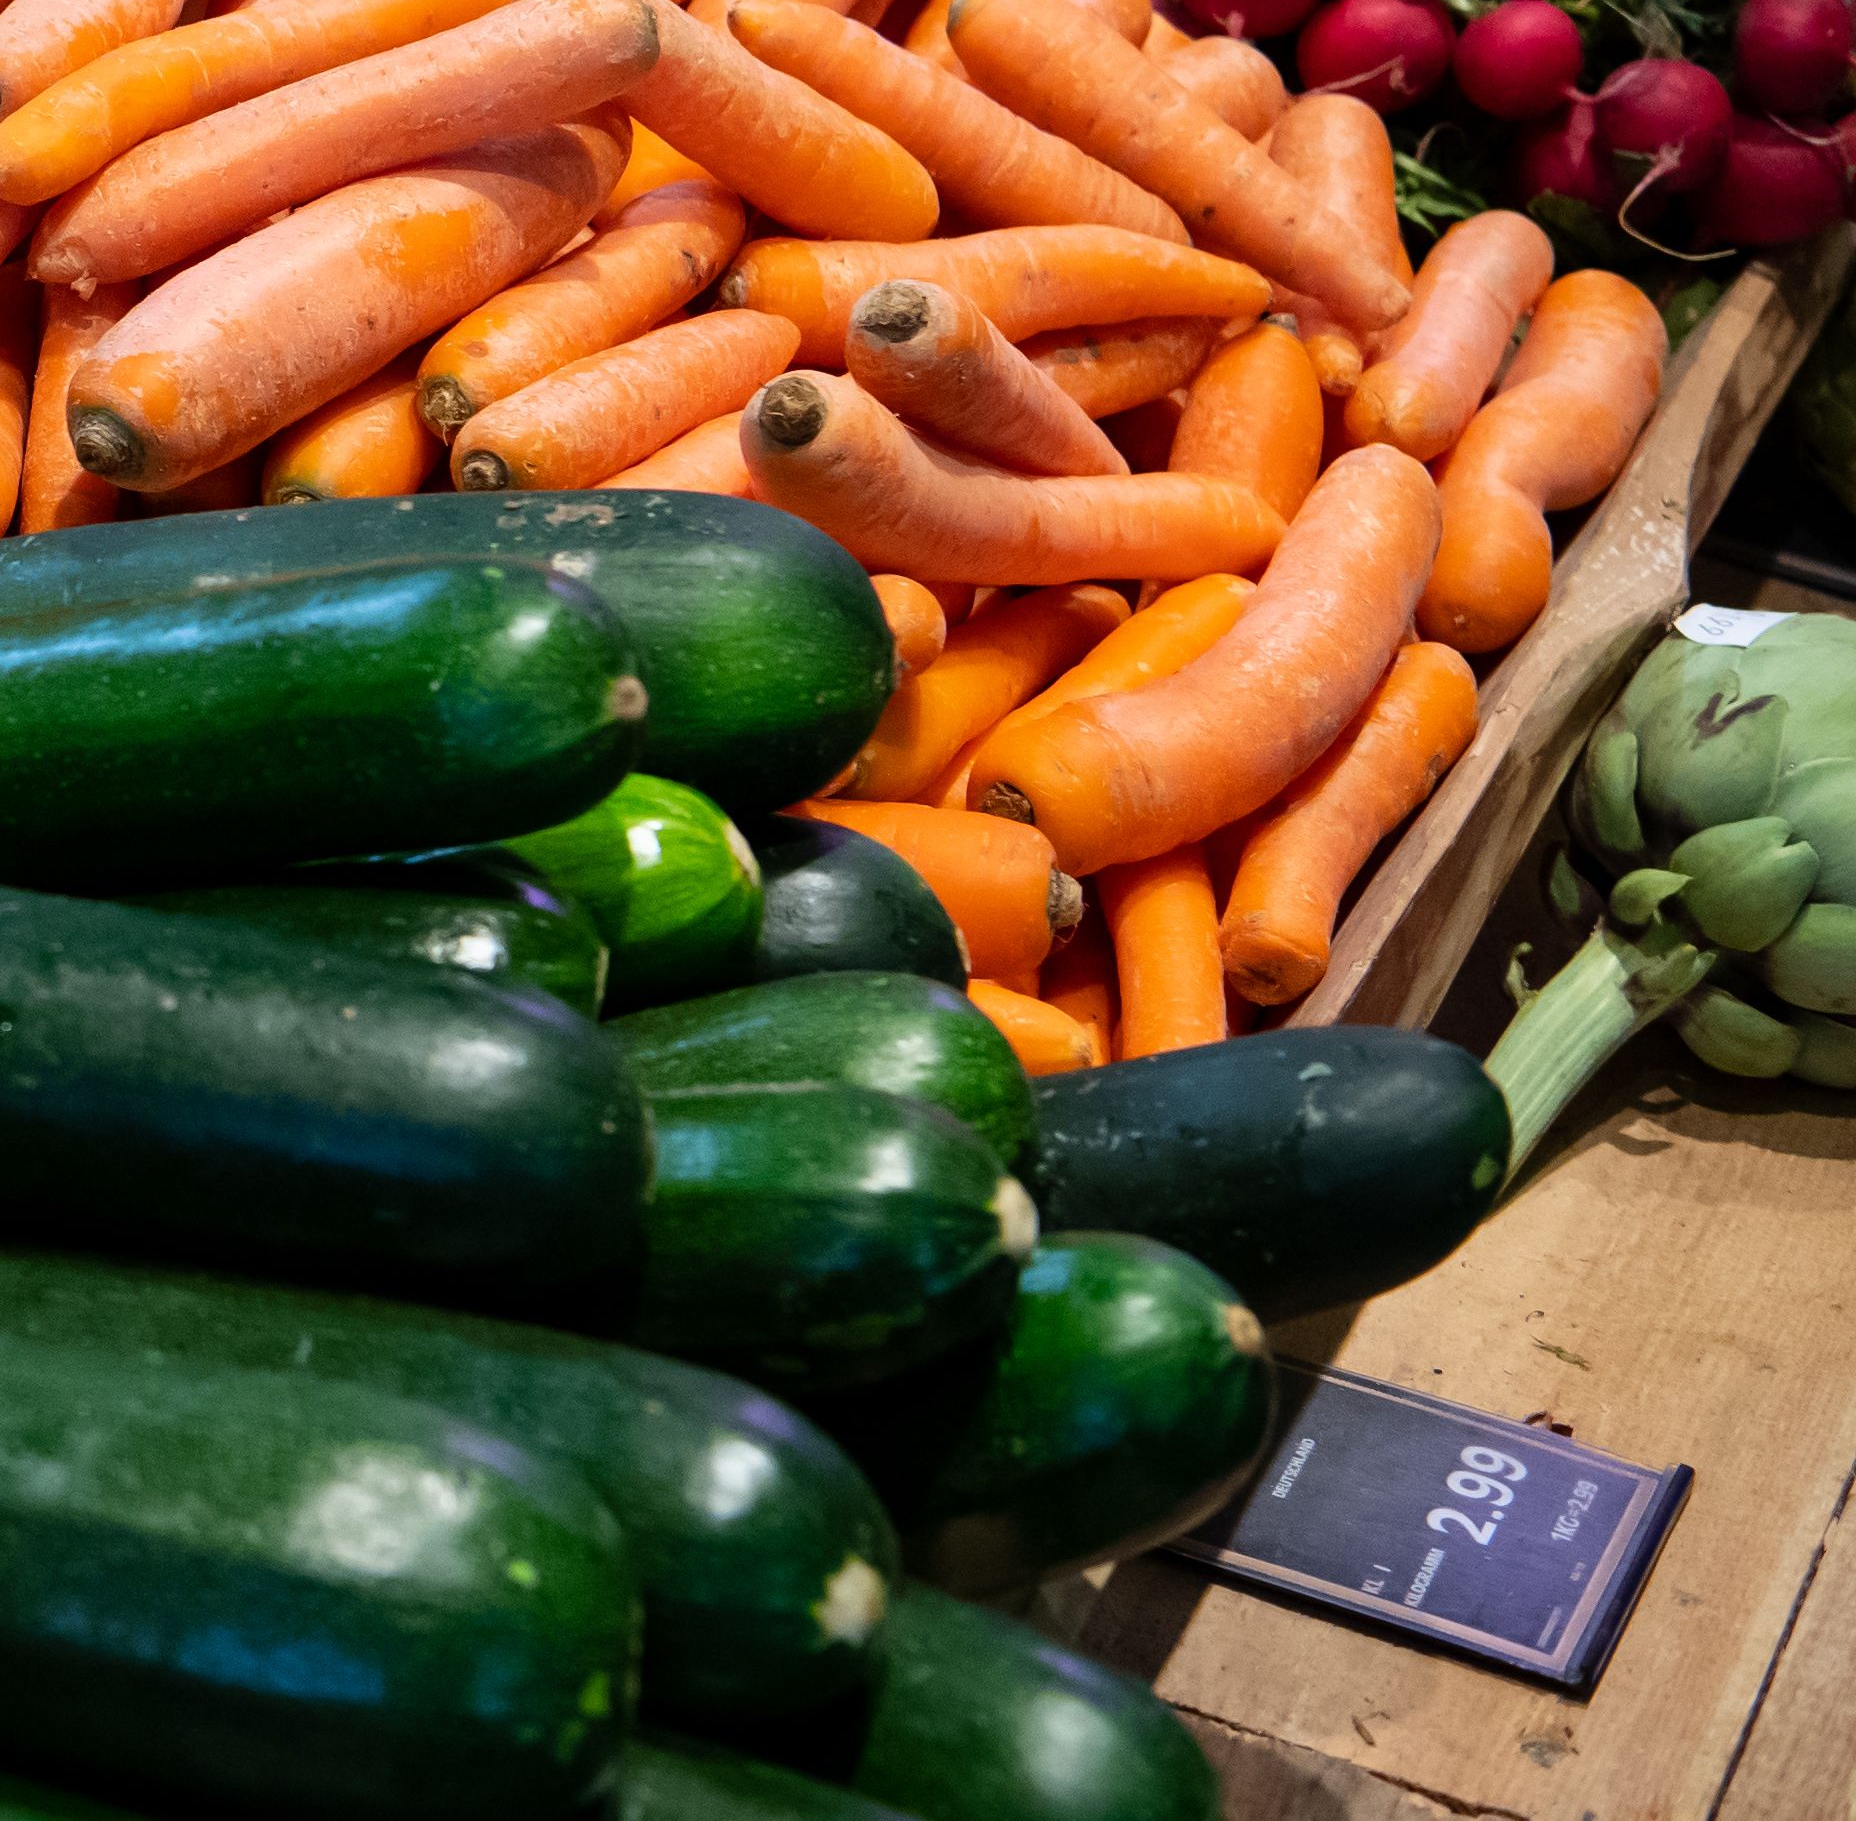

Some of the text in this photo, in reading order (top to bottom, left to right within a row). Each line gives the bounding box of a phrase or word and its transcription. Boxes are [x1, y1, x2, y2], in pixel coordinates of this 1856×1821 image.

[1272, 1437, 1317, 1501] DEUTSCHLAND
[1426, 1445, 1528, 1546] 2.99
[1361, 1576, 1386, 1596] KL
[1403, 1547, 1448, 1609] KILOGRAMM
